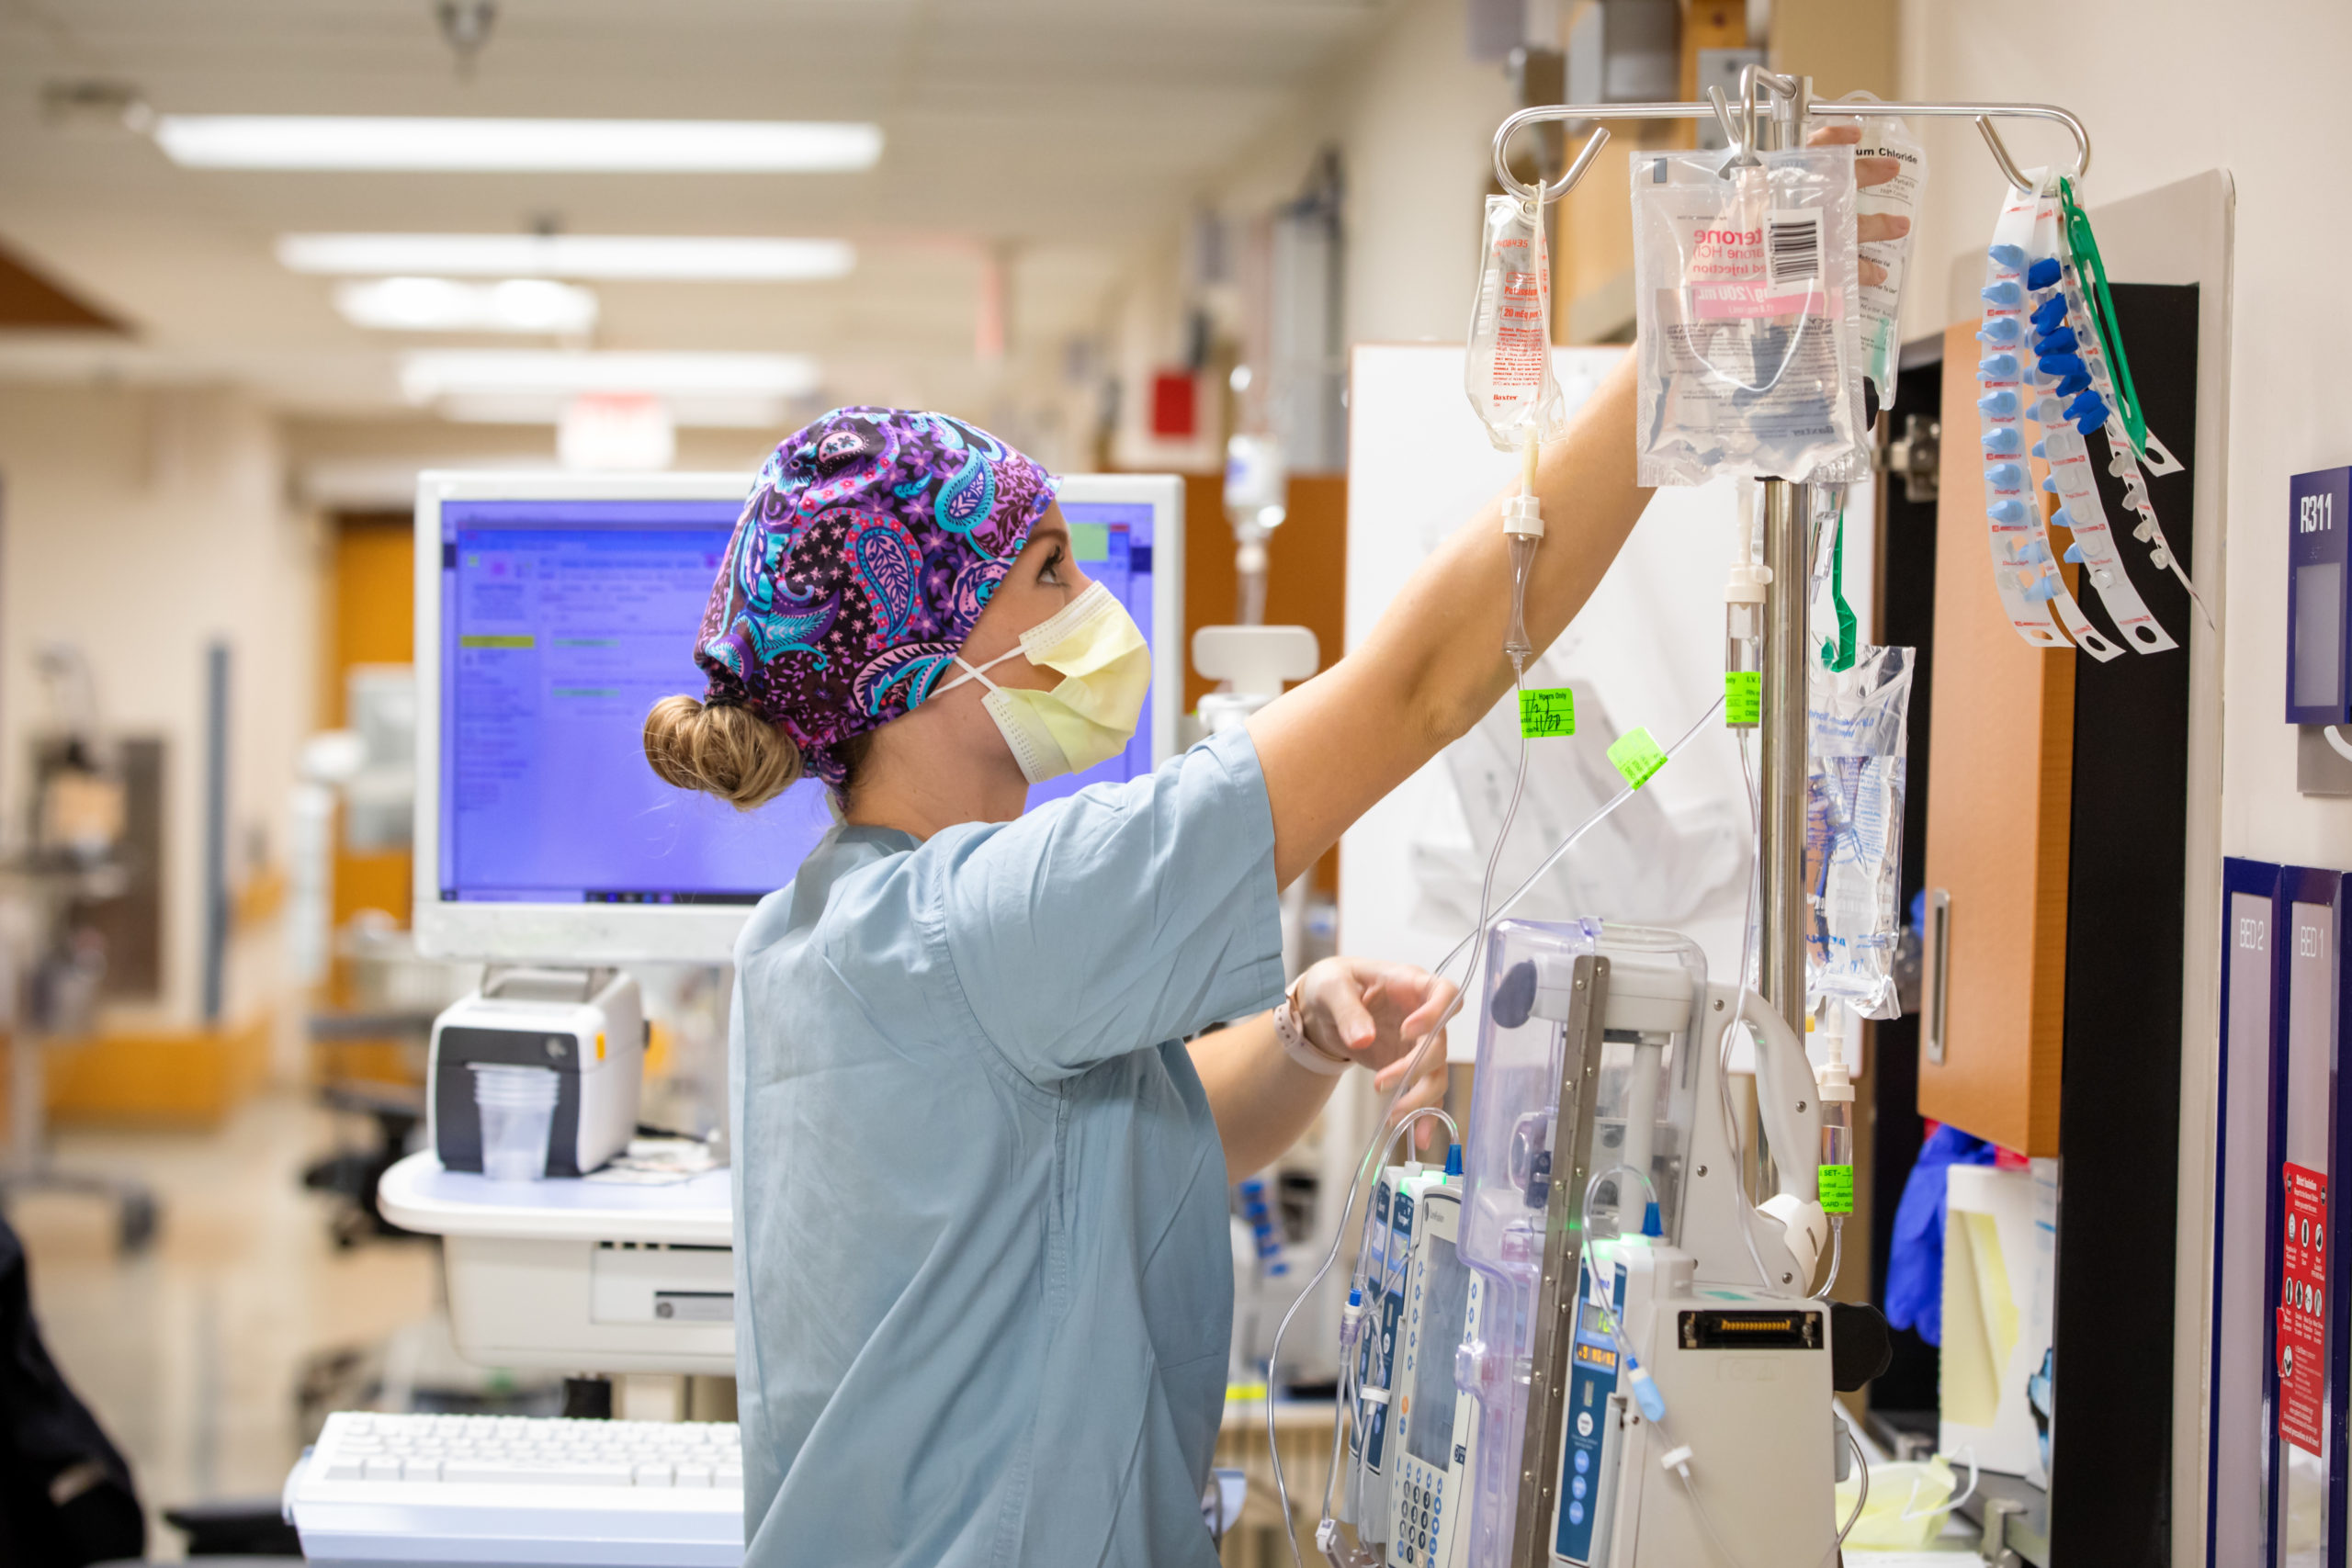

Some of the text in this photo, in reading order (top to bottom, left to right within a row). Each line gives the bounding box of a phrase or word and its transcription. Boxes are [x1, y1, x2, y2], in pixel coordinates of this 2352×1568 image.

[1878, 147, 1918, 164] Chloride
[1504, 308, 1514, 317] 20
[2300, 492, 2333, 533] R311
[1555, 692, 1566, 700] Only
[2239, 918, 2265, 951] BED 2
[2300, 926, 2324, 959] BED 1
